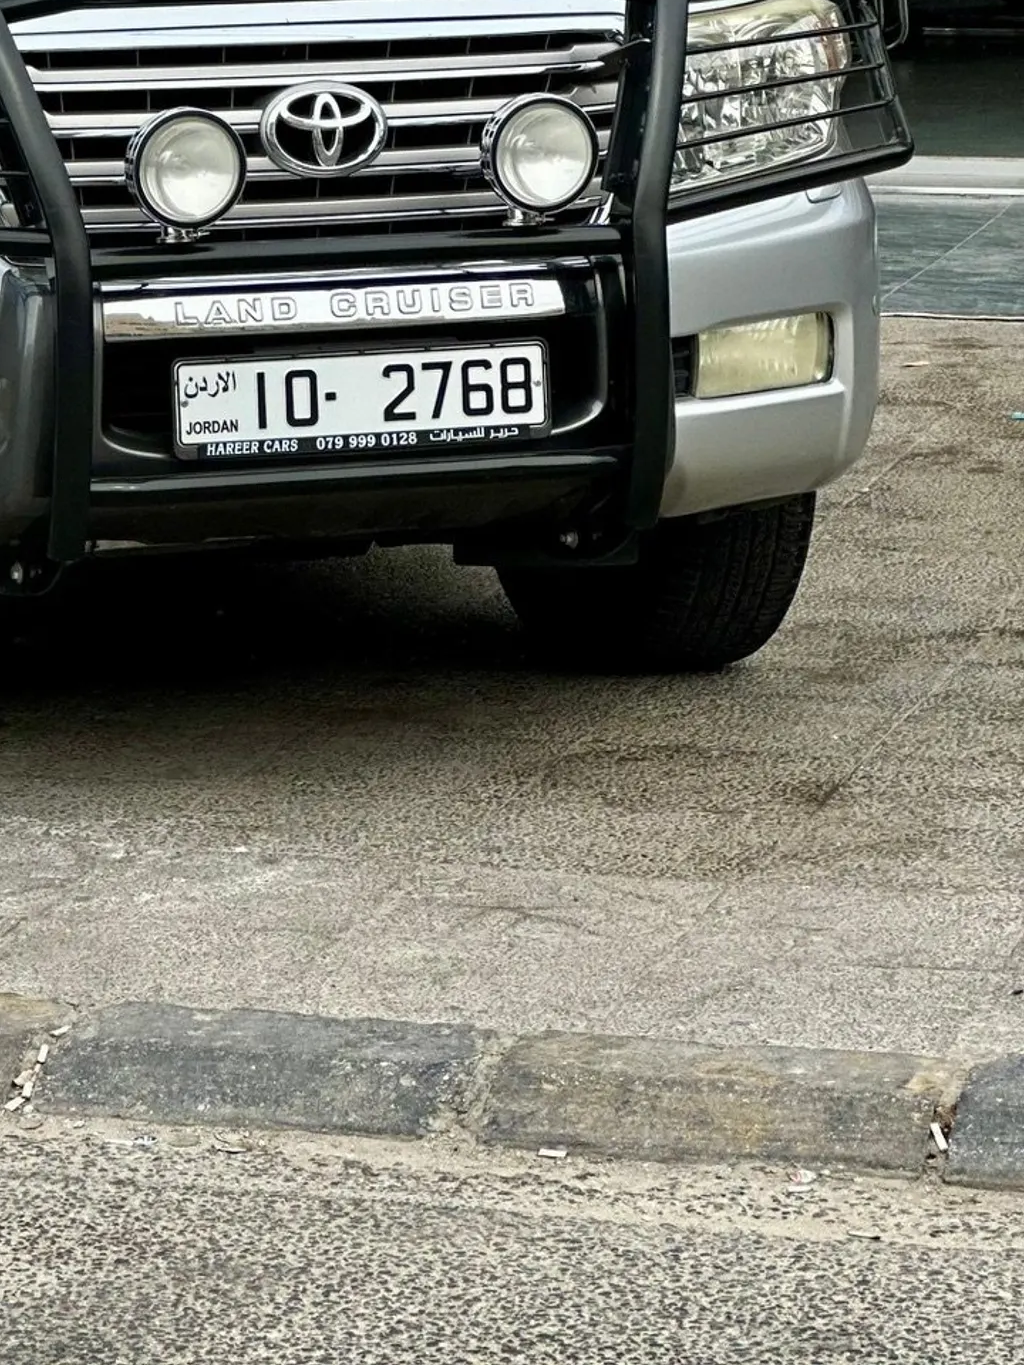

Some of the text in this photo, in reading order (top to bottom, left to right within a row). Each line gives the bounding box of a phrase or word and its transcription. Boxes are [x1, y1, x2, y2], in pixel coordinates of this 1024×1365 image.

[174, 282, 534, 327] LAND CRUISER
[382, 357, 533, 422] 2768
[185, 419, 239, 436] JORDAN
[206, 431, 418, 457] HAREER CARS 079 999 0128
